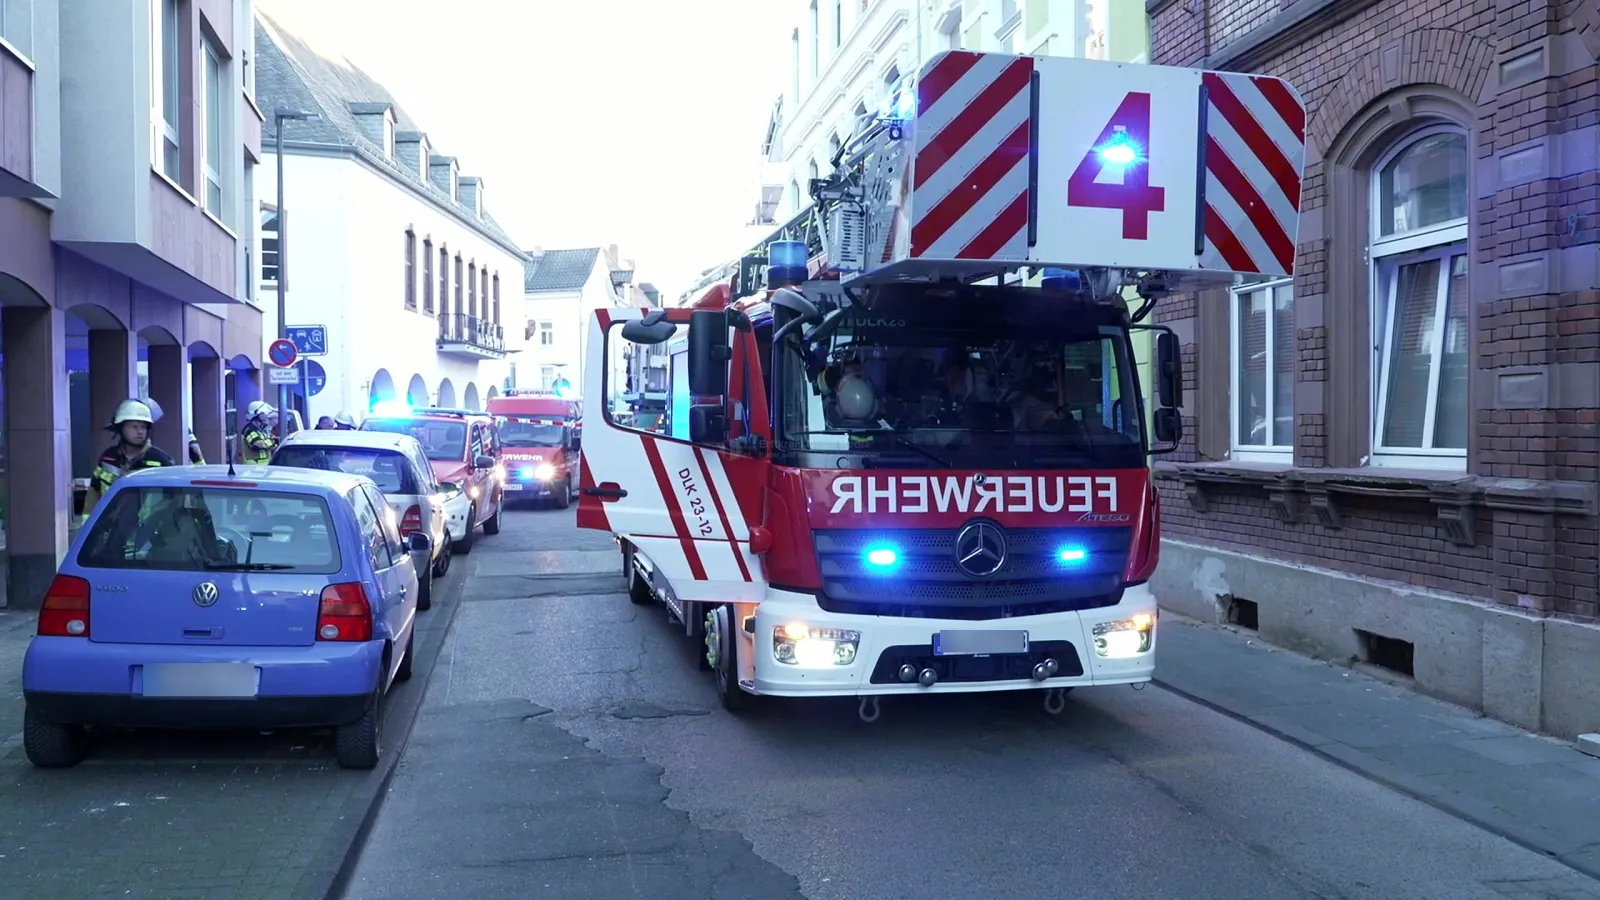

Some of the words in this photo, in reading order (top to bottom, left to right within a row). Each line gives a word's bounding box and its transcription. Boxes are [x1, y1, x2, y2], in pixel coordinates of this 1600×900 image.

[1067, 91, 1165, 240] 4
[678, 468, 698, 496] DLK
[690, 497, 713, 537] 23-12
